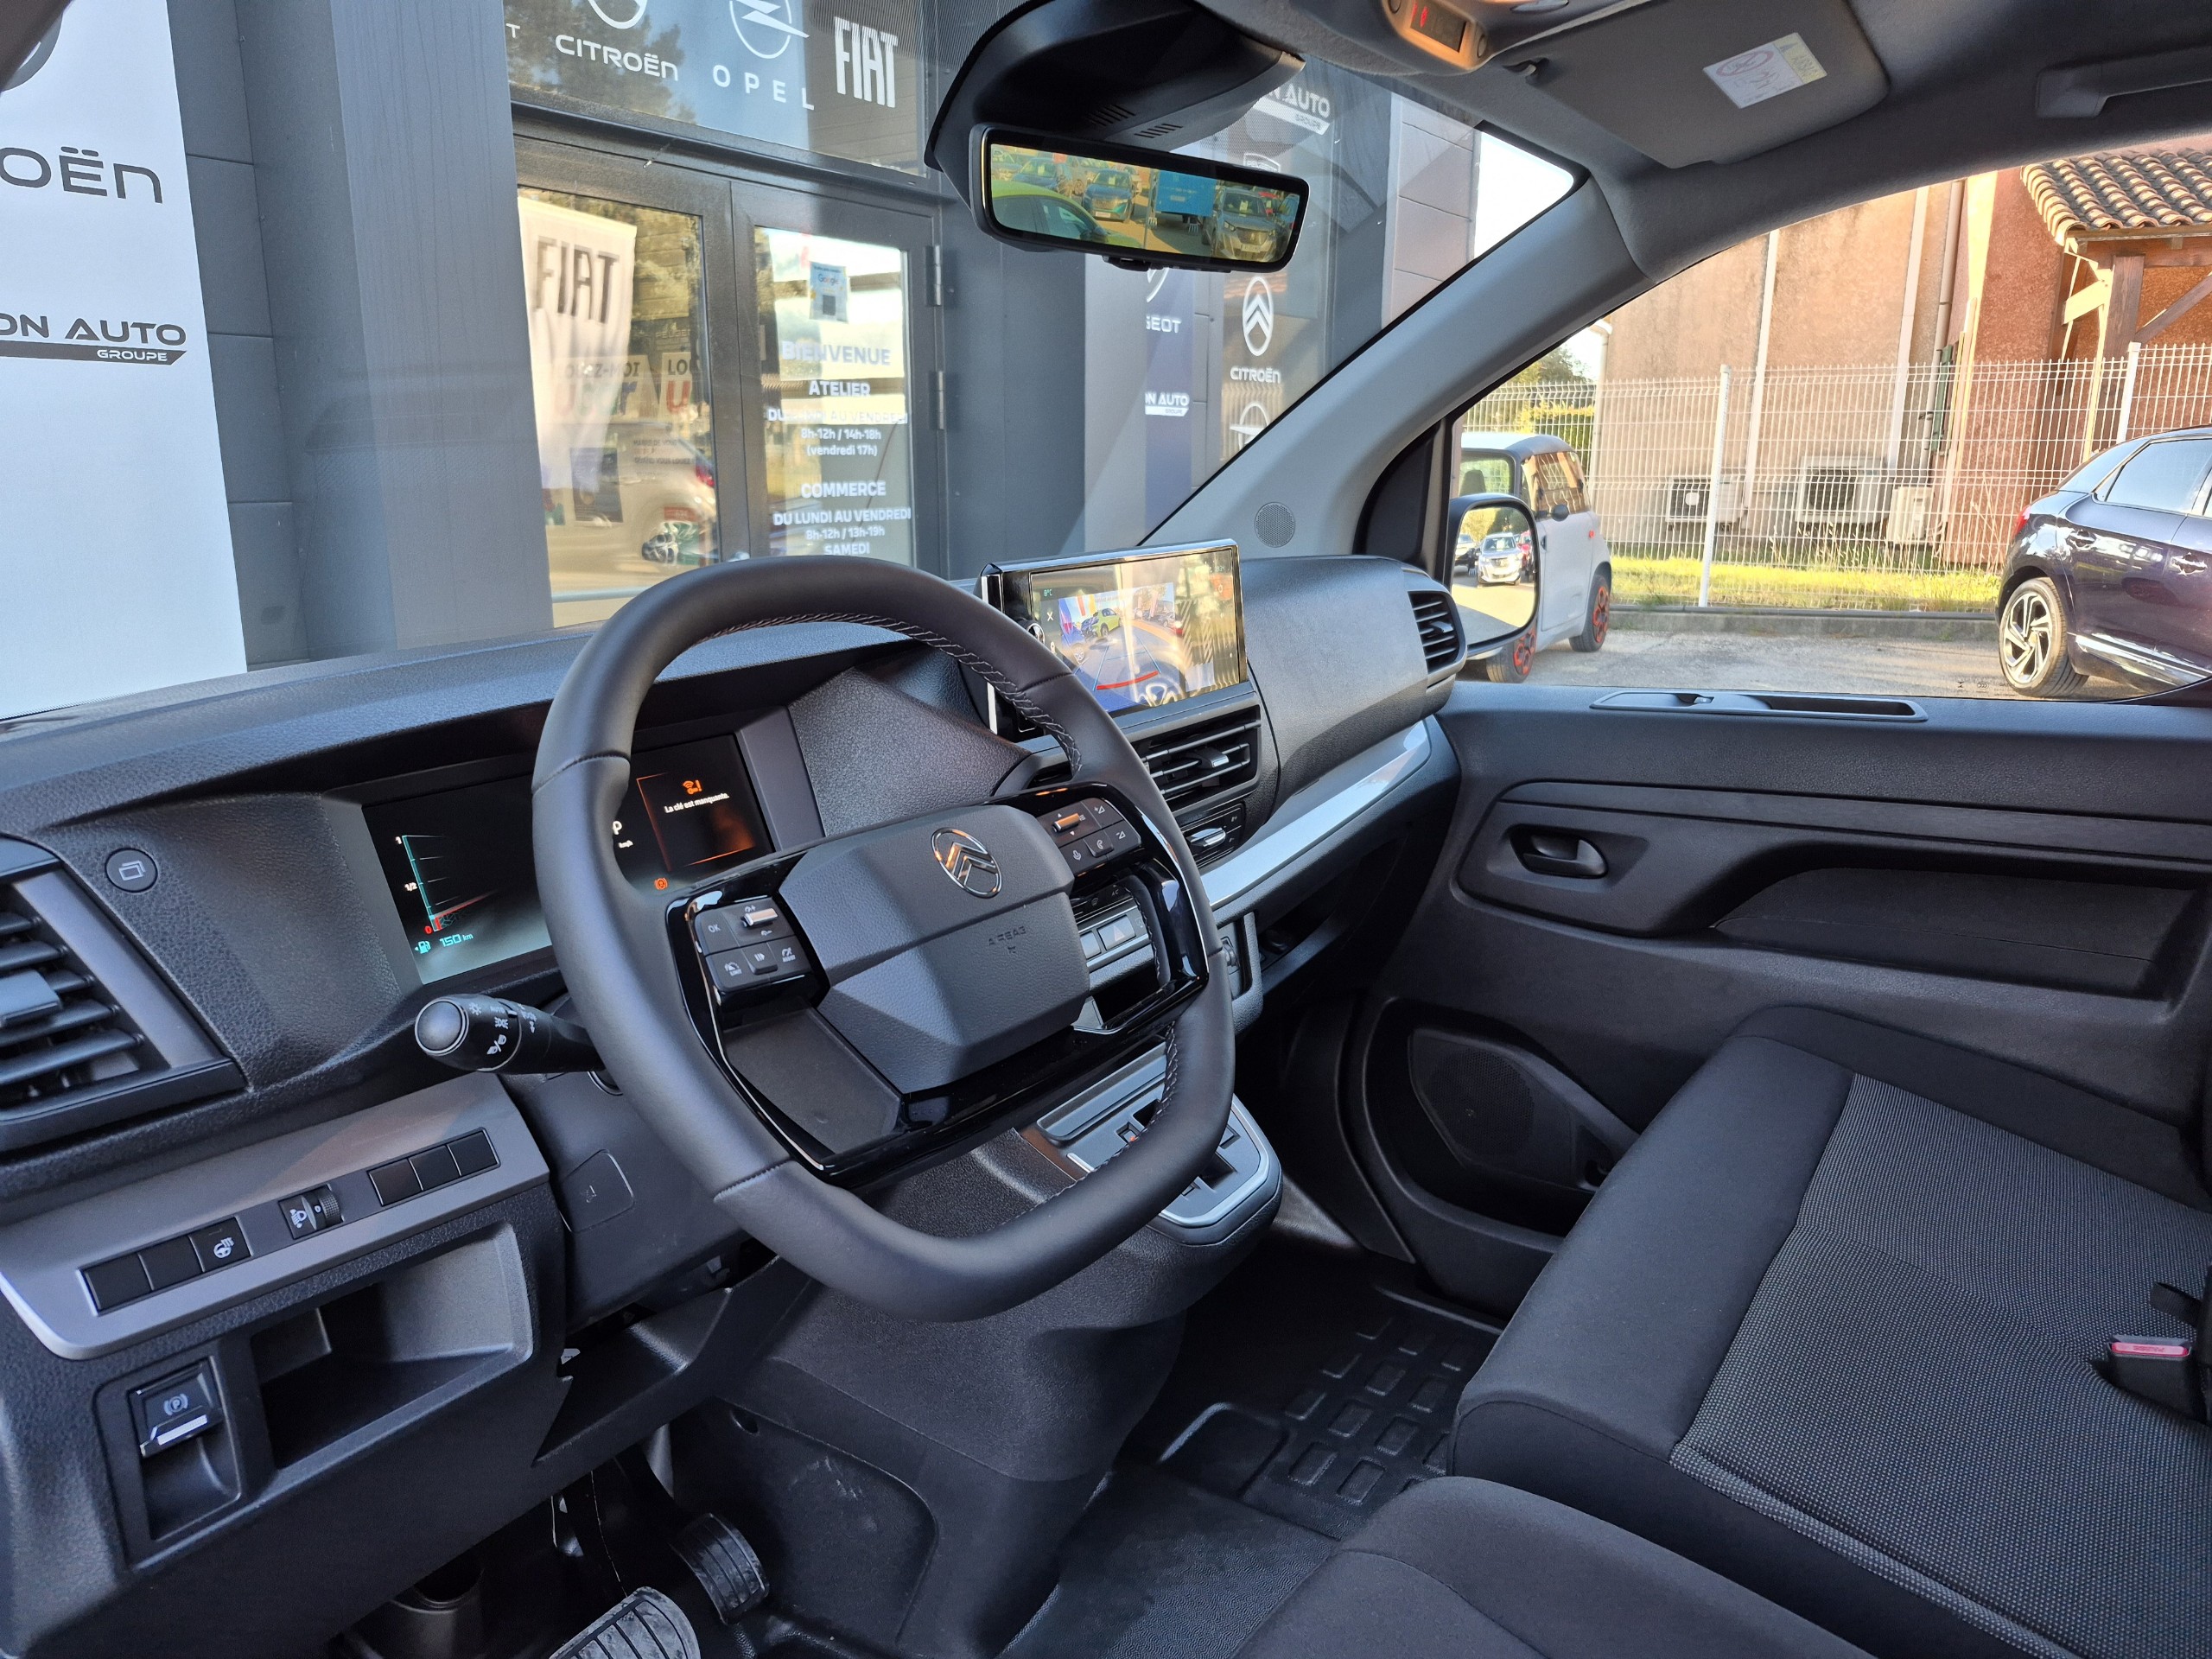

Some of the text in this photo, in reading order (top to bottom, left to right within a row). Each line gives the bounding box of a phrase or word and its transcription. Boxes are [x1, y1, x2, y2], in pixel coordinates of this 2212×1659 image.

[556, 35, 678, 81] CITROËN
[834, 16, 899, 108] FIAT
[713, 64, 815, 111] OPEL
[1282, 83, 1331, 118] AUTO
[533, 235, 620, 324] FIAT
[65, 318, 187, 346] AUTO
[97, 349, 168, 362] GROUPE
[782, 340, 892, 365] BIENVENUE
[668, 359, 692, 375] LO
[809, 380, 871, 397] ATELIER
[1158, 391, 1190, 406] AUTO
[801, 429, 836, 440] 8h-12h
[846, 429, 881, 440] 14h-18h
[807, 445, 878, 456] (vendredi 17h)
[801, 480, 887, 499] COMMERCE
[773, 508, 911, 525] DU LUNDI AU VENDREDI
[806, 529, 840, 540] 8h-12h
[848, 526, 885, 537] 13h-19h
[824, 542, 870, 556] SAMEDI
[613, 821, 622, 835] P
[709, 924, 721, 933] OK
[440, 934, 461, 947] 150
